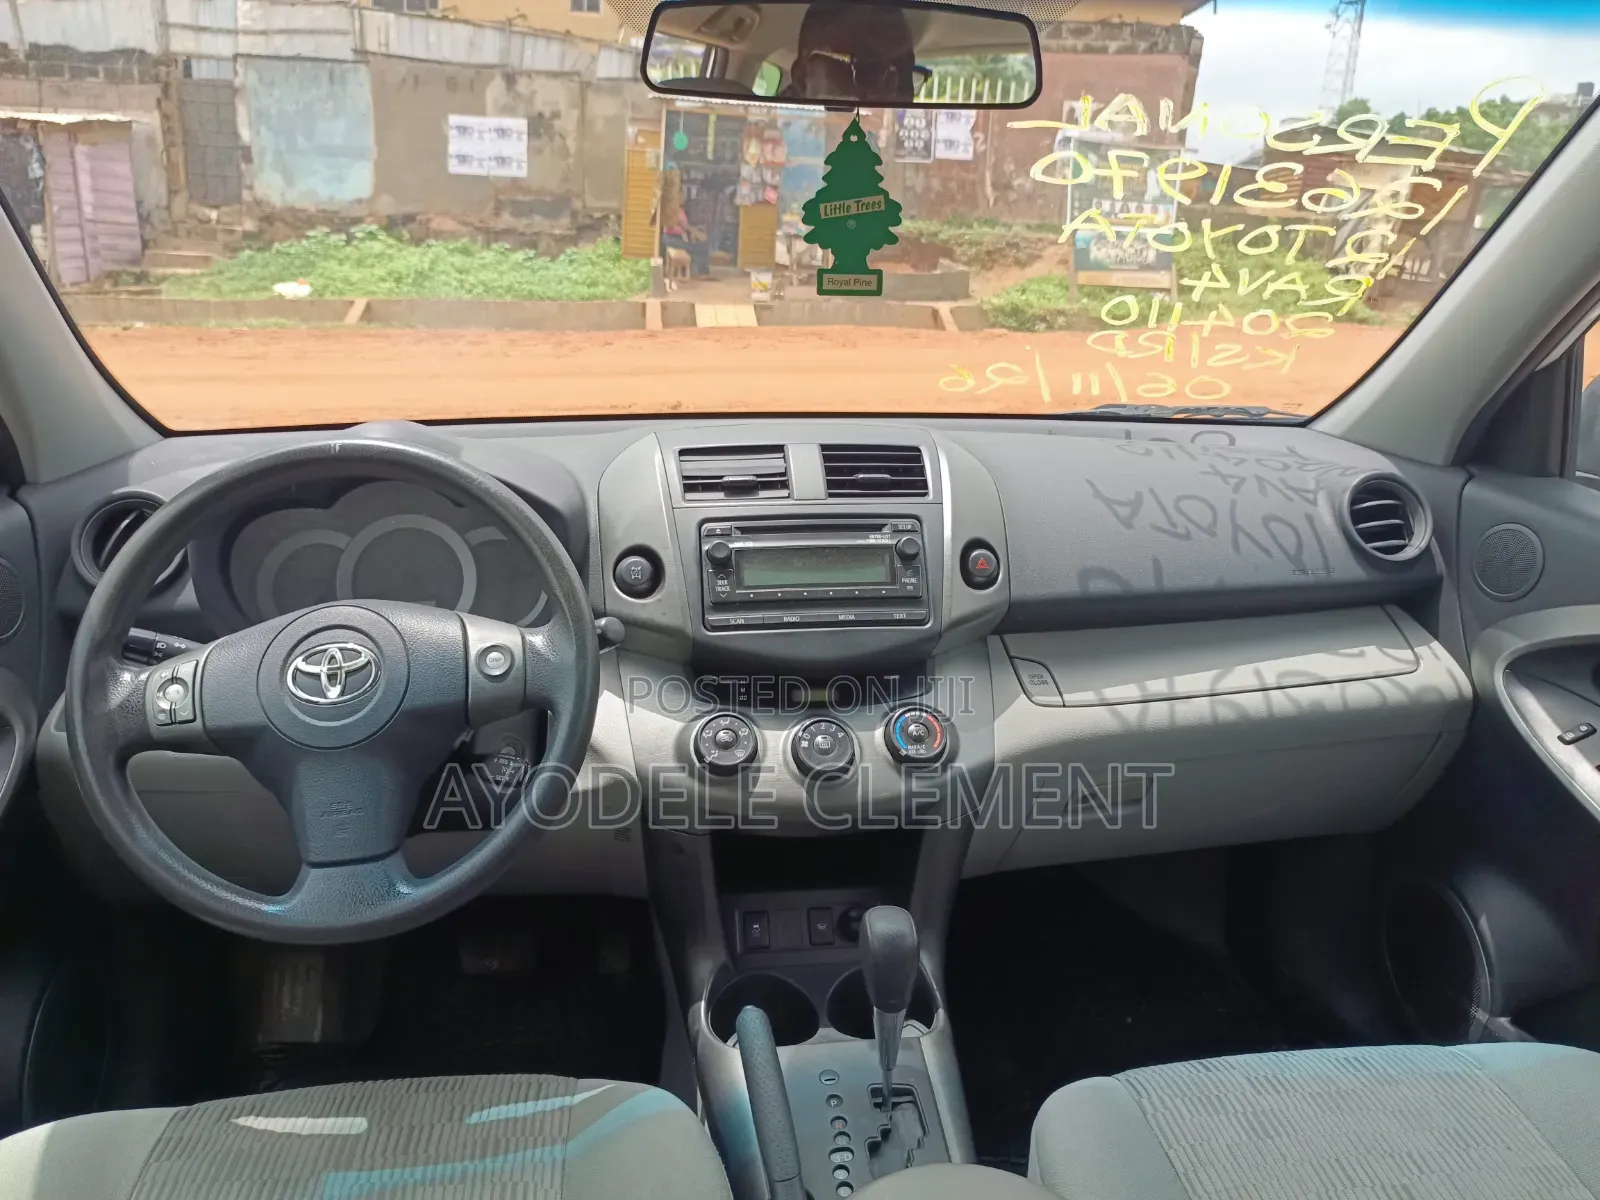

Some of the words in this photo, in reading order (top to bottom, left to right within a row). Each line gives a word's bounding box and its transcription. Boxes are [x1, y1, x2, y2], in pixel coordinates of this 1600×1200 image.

[823, 202, 852, 217] Little
[854, 199, 882, 212] Trees
[827, 277, 851, 288] Royal
[853, 278, 873, 287] Pine
[783, 615, 800, 623] RADIO
[830, 1099, 837, 1107] P
